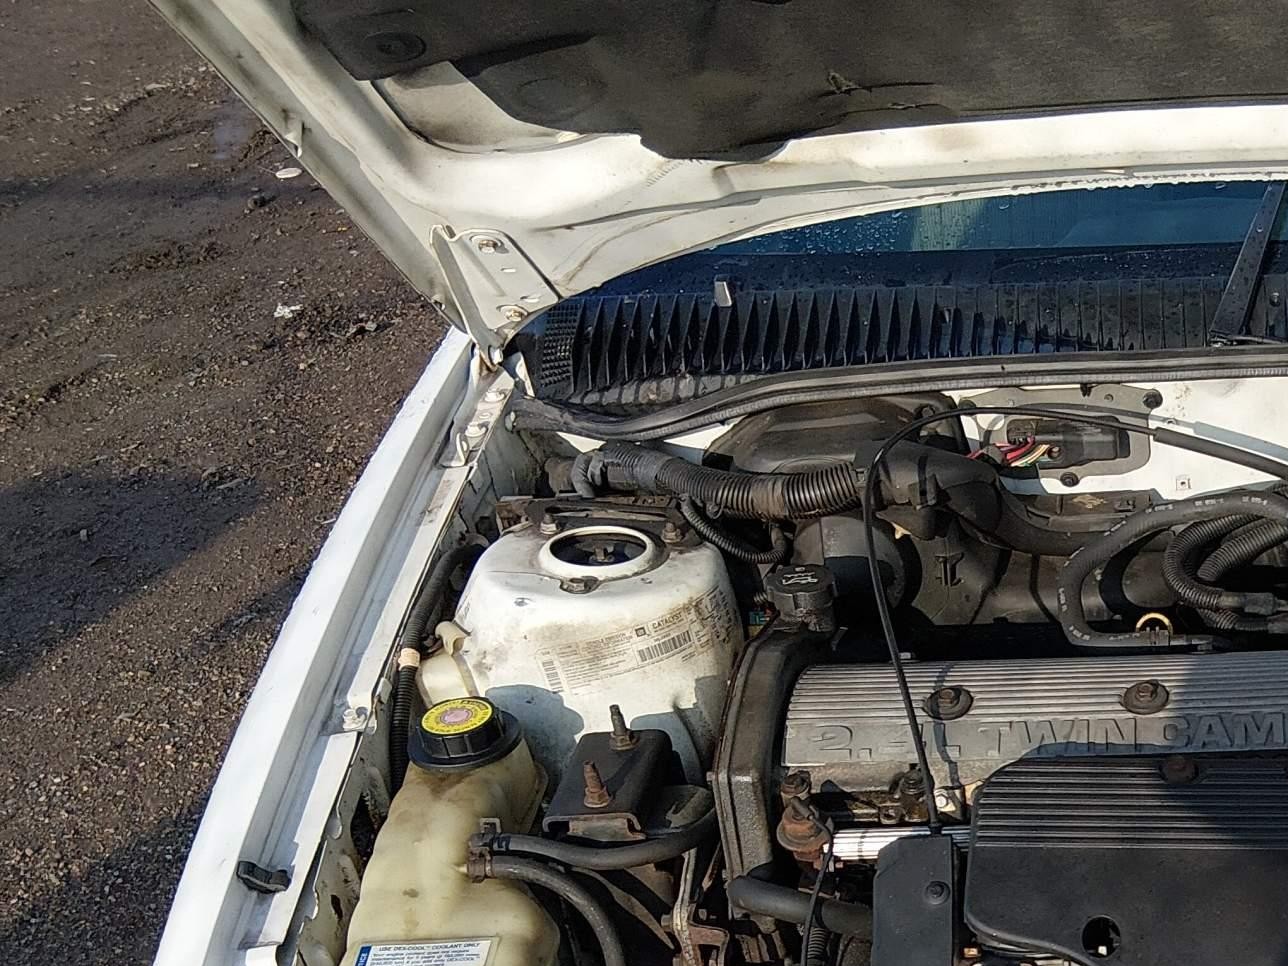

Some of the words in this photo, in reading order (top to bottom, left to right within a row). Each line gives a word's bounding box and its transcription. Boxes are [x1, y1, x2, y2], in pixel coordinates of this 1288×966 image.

[652, 612, 682, 629] CATALYST
[976, 716, 1139, 759] TWIN
[1160, 711, 1288, 752] CAM
